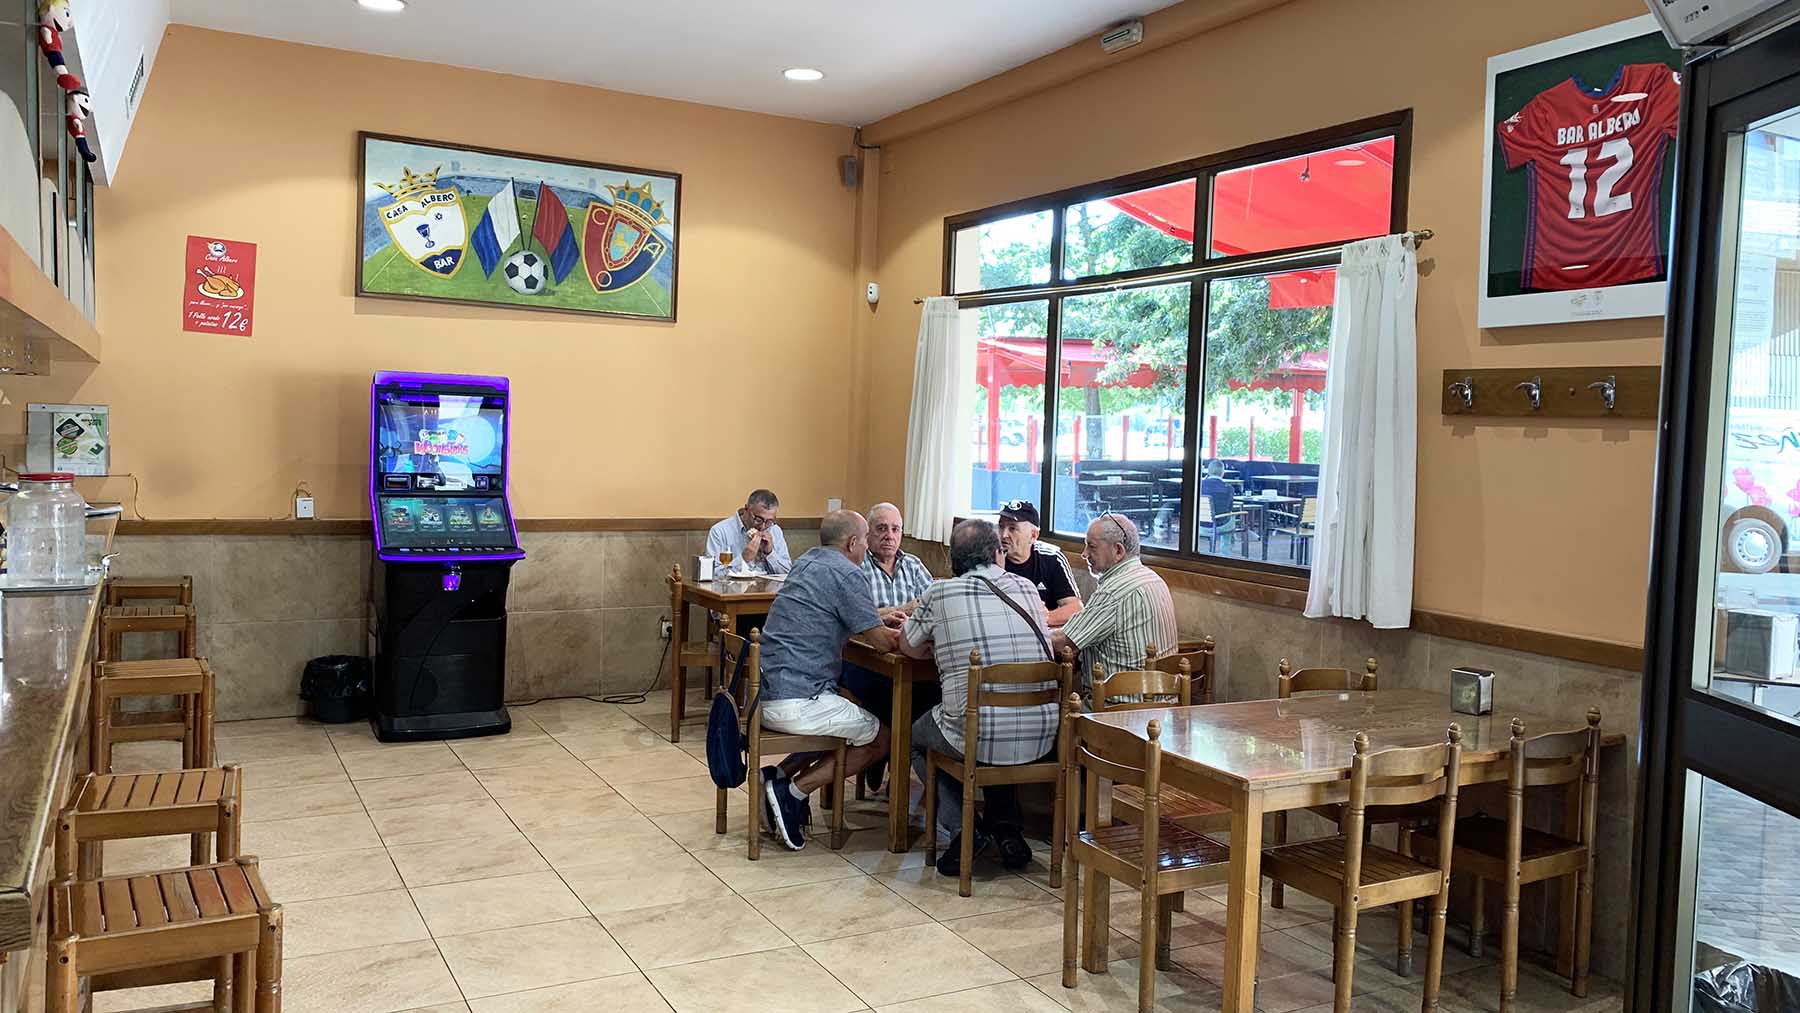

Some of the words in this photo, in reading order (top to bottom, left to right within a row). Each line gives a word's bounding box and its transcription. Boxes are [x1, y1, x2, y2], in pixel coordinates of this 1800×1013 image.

[1557, 125, 1584, 145] BAR
[1588, 108, 1641, 141] ALBERO
[1560, 137, 1634, 219] 12
[386, 205, 408, 219] CASA
[421, 193, 455, 208] ALBERO
[434, 256, 455, 269] BAR
